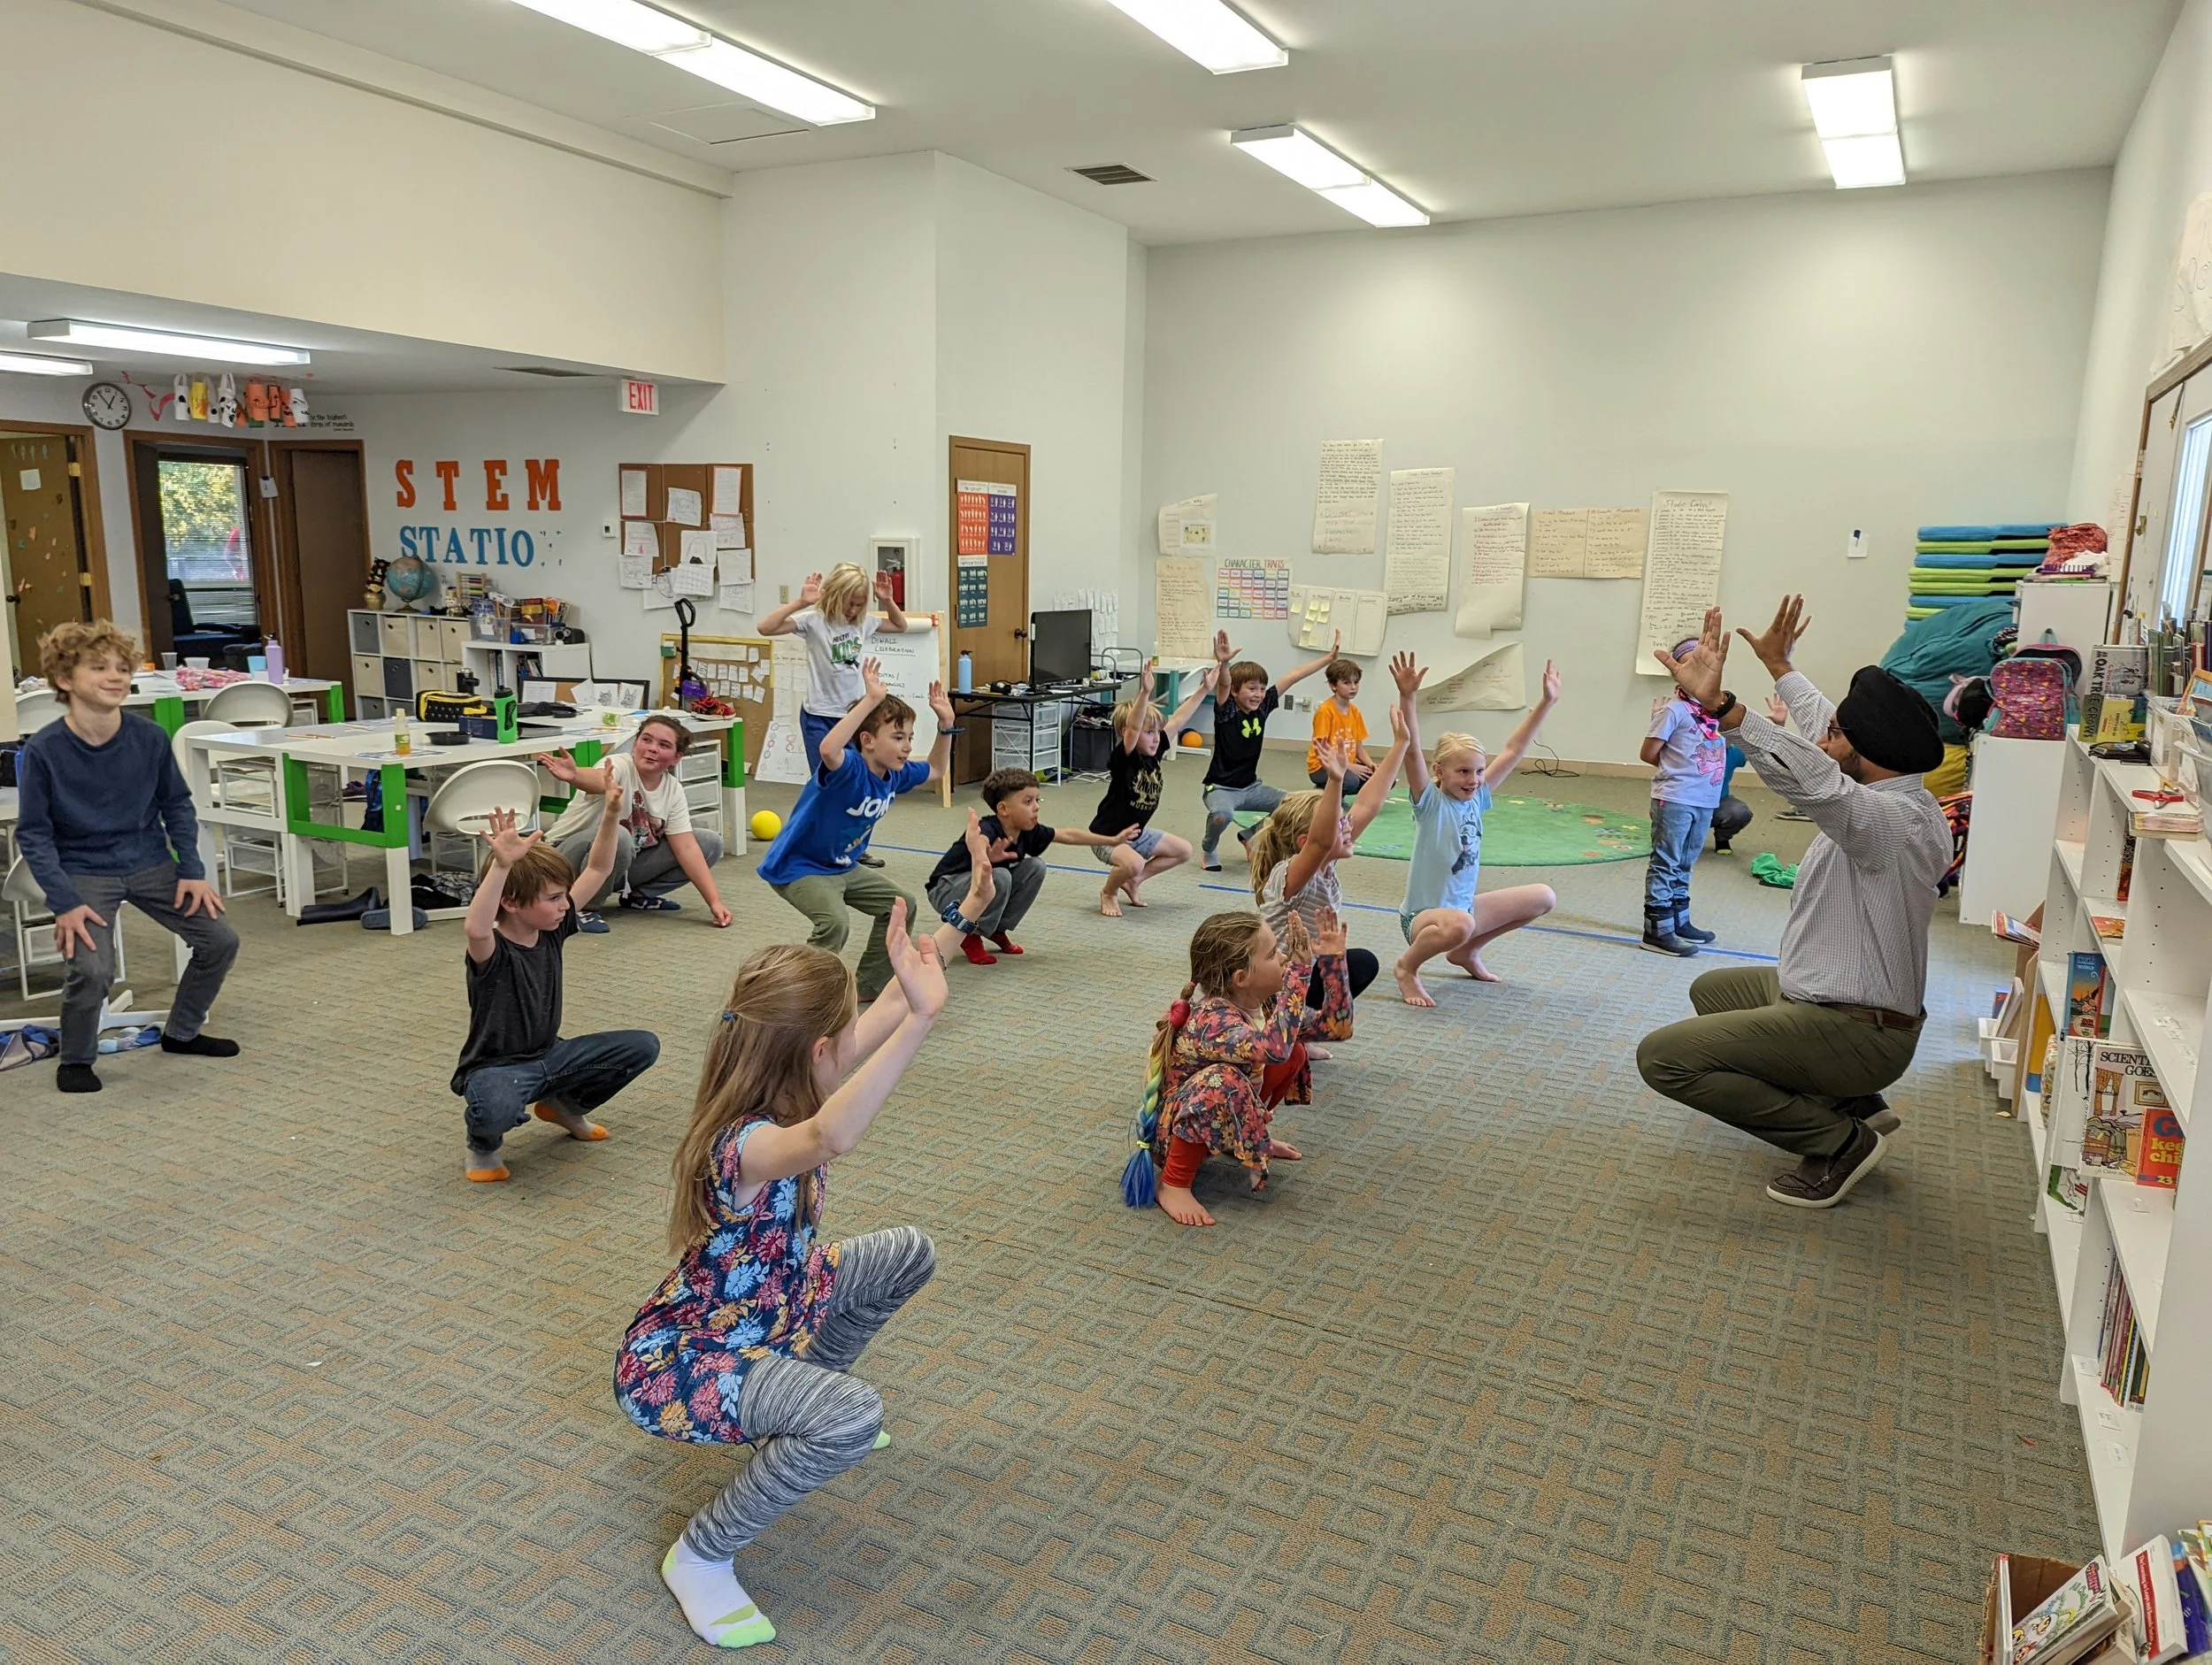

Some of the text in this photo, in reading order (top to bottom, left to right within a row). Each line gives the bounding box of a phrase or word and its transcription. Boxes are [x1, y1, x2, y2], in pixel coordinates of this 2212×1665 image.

[628, 381, 654, 411] EXIT
[396, 459, 562, 510] STEM
[1224, 558, 1285, 569] CHARACTER TRAITS
[2093, 658, 2108, 679] OAK
[2090, 680, 2103, 703] TREE
[2084, 706, 2099, 738] GROWS
[2125, 1065, 2156, 1078] GOES
[2156, 1176, 2174, 1185] 23
